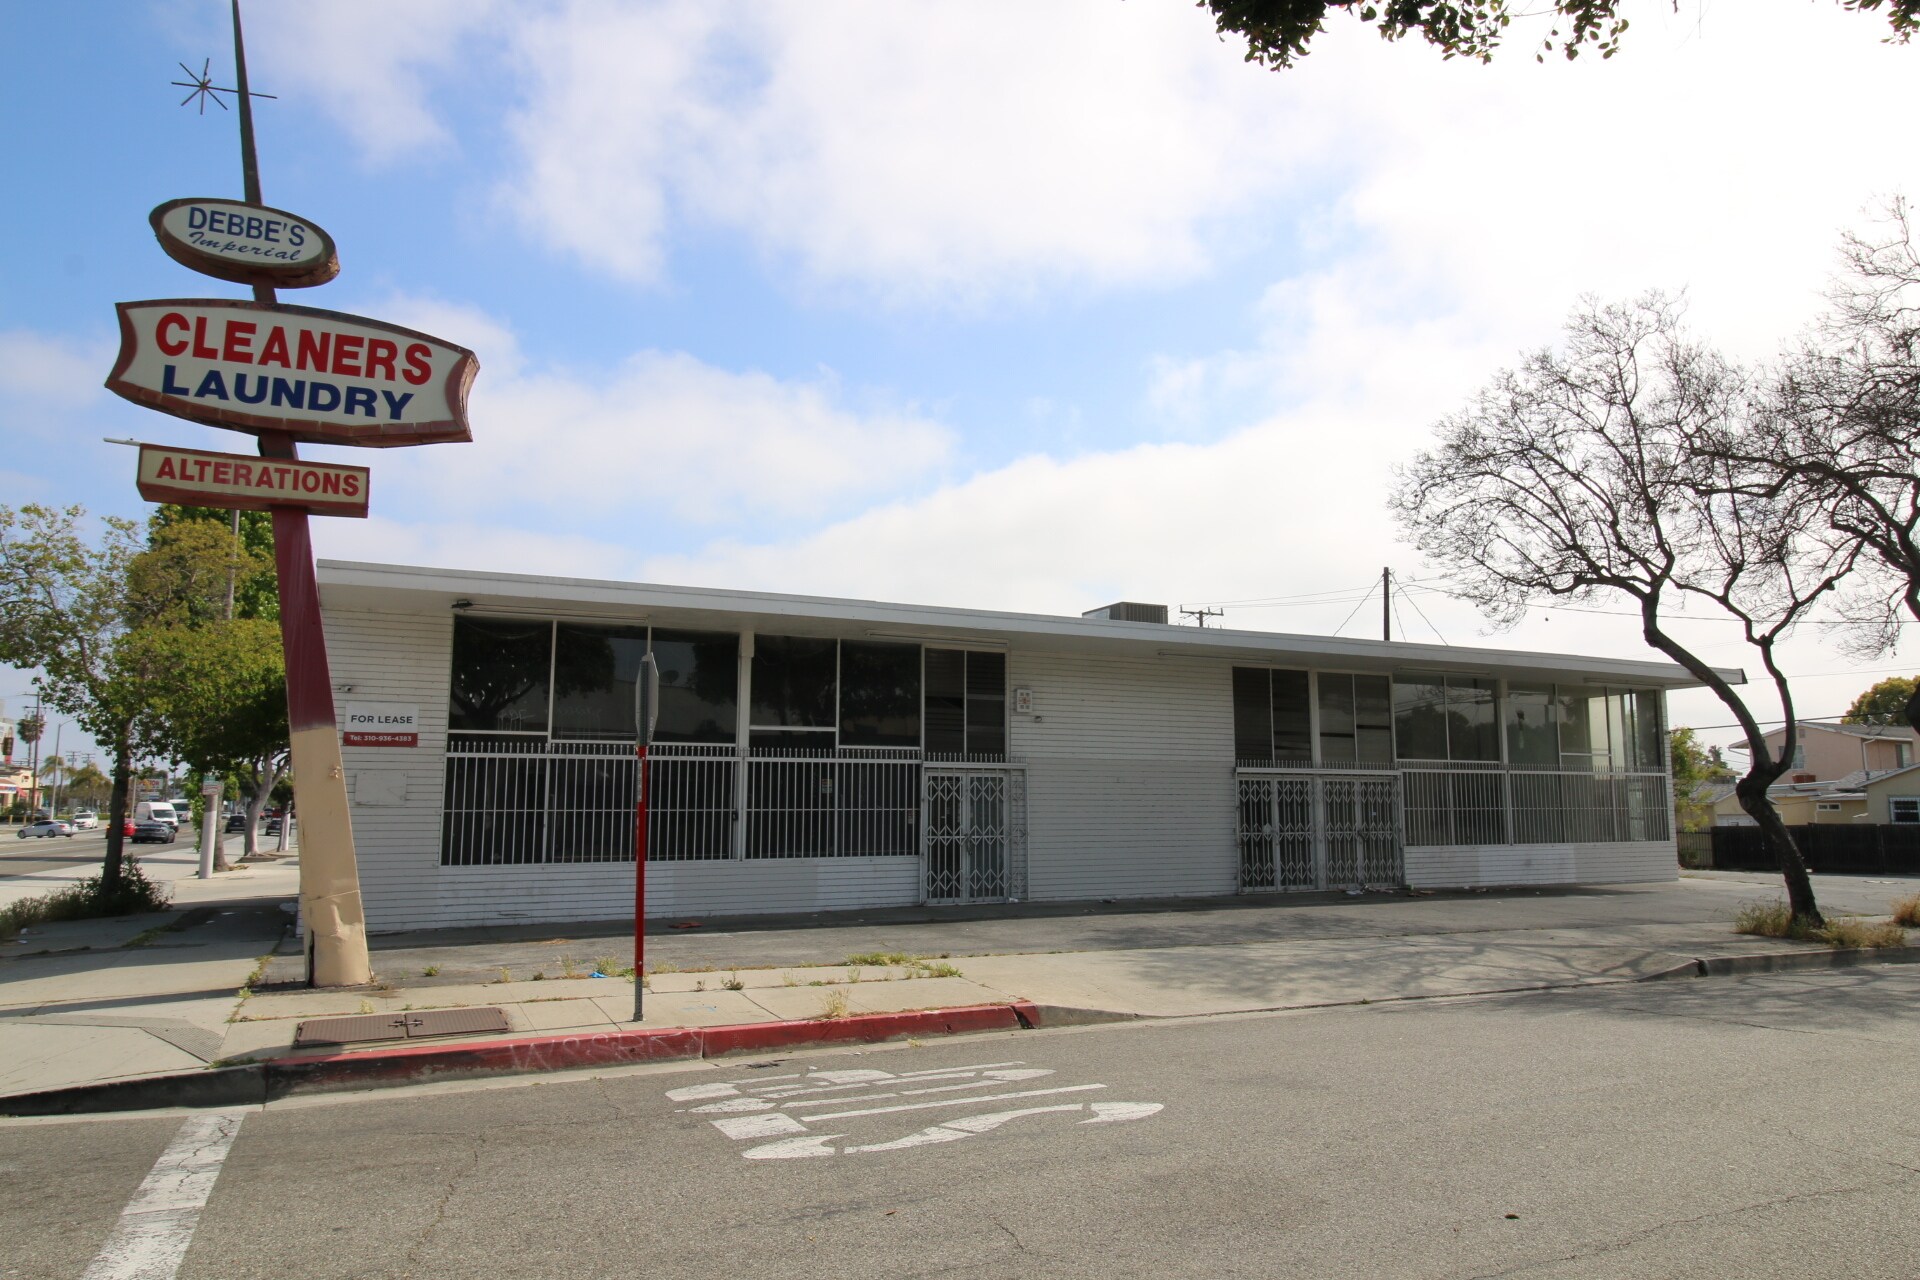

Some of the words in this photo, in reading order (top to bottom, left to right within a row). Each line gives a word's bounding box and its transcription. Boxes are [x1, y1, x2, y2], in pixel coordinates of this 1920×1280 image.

[188, 206, 305, 247] DEBBE'S
[188, 231, 301, 261] Imperial
[155, 312, 433, 385] CLEANERS
[161, 364, 414, 420] LAUNDRY
[156, 456, 359, 497] ALTERATIONS
[351, 715, 374, 723] FOR
